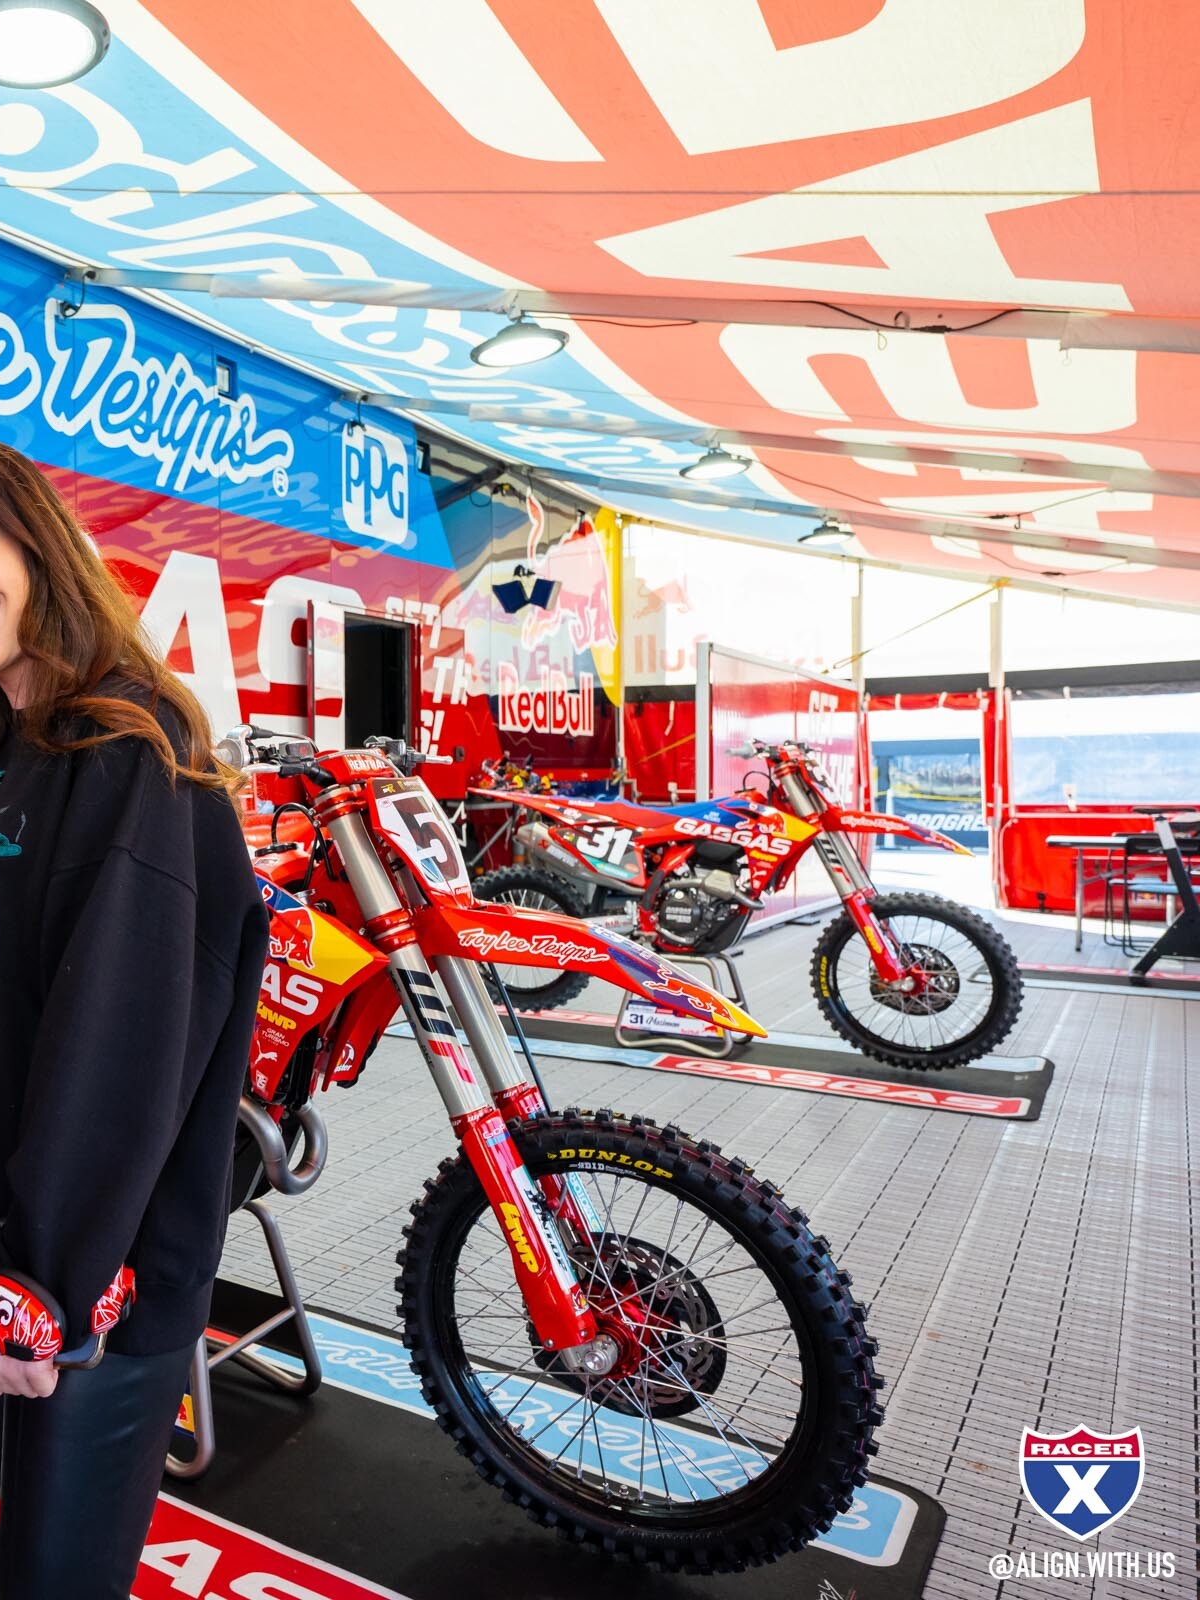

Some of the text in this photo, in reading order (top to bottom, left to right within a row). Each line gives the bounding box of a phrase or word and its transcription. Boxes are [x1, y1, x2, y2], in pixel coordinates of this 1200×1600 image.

[43, 297, 294, 492] Designs
[345, 434, 404, 526] PPG
[499, 662, 594, 737] Red Bull
[576, 825, 633, 865] 31
[674, 818, 793, 855] GASGAS
[458, 927, 497, 956] Troy
[496, 930, 530, 950] Lee
[530, 935, 610, 965] Designs
[266, 1027, 285, 1040] GRAN
[629, 1013, 645, 1026] 31
[261, 1030, 290, 1048] TURISMO
[675, 1060, 1003, 1110] GASGAS
[559, 1148, 673, 1179] DUNLOP
